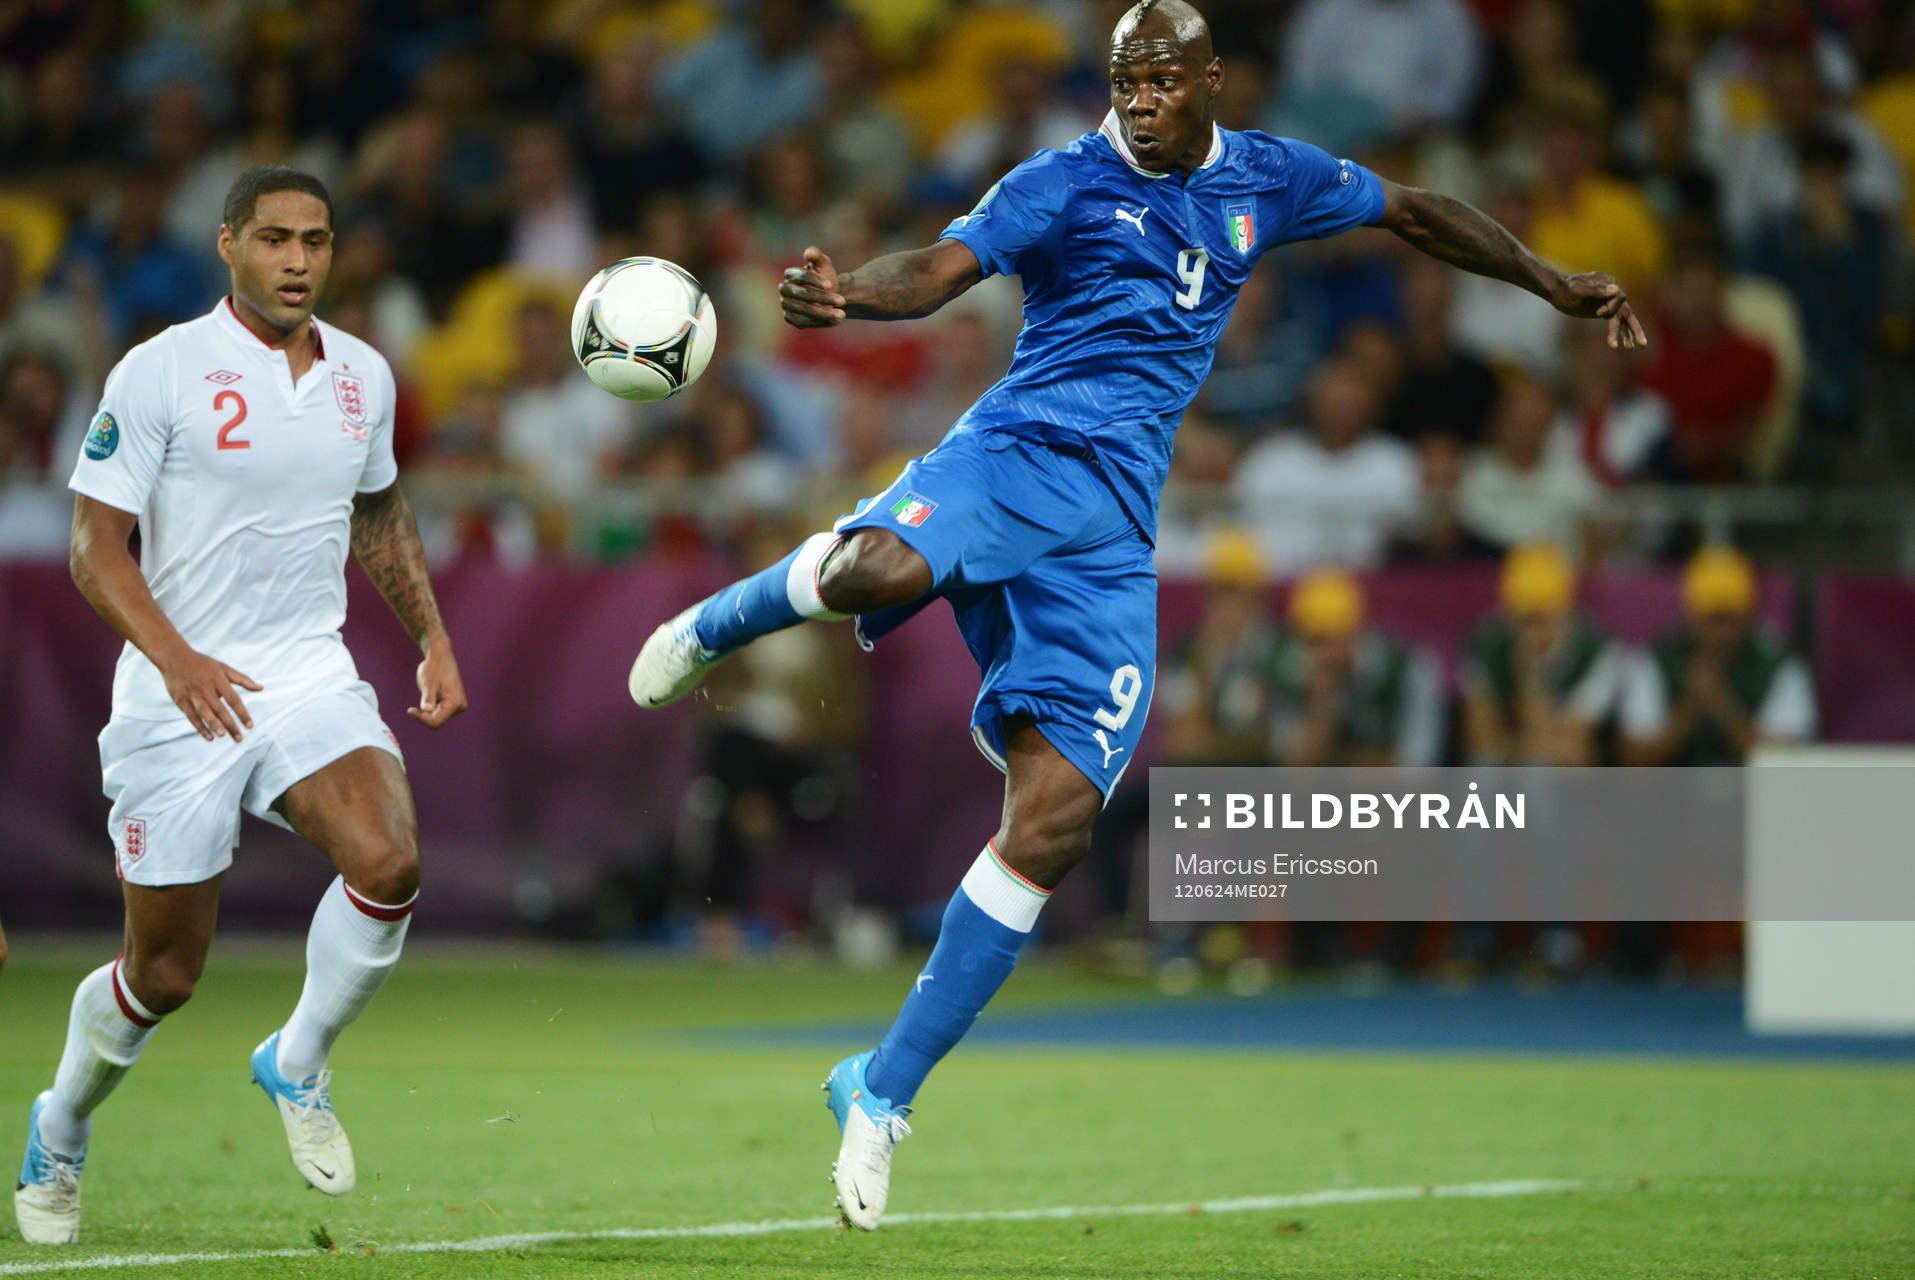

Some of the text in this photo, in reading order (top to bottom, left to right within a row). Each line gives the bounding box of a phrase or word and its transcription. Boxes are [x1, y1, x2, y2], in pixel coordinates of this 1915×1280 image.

[1176, 247, 1210, 310] 9
[213, 390, 250, 450] 2
[1093, 664, 1142, 732] 9
